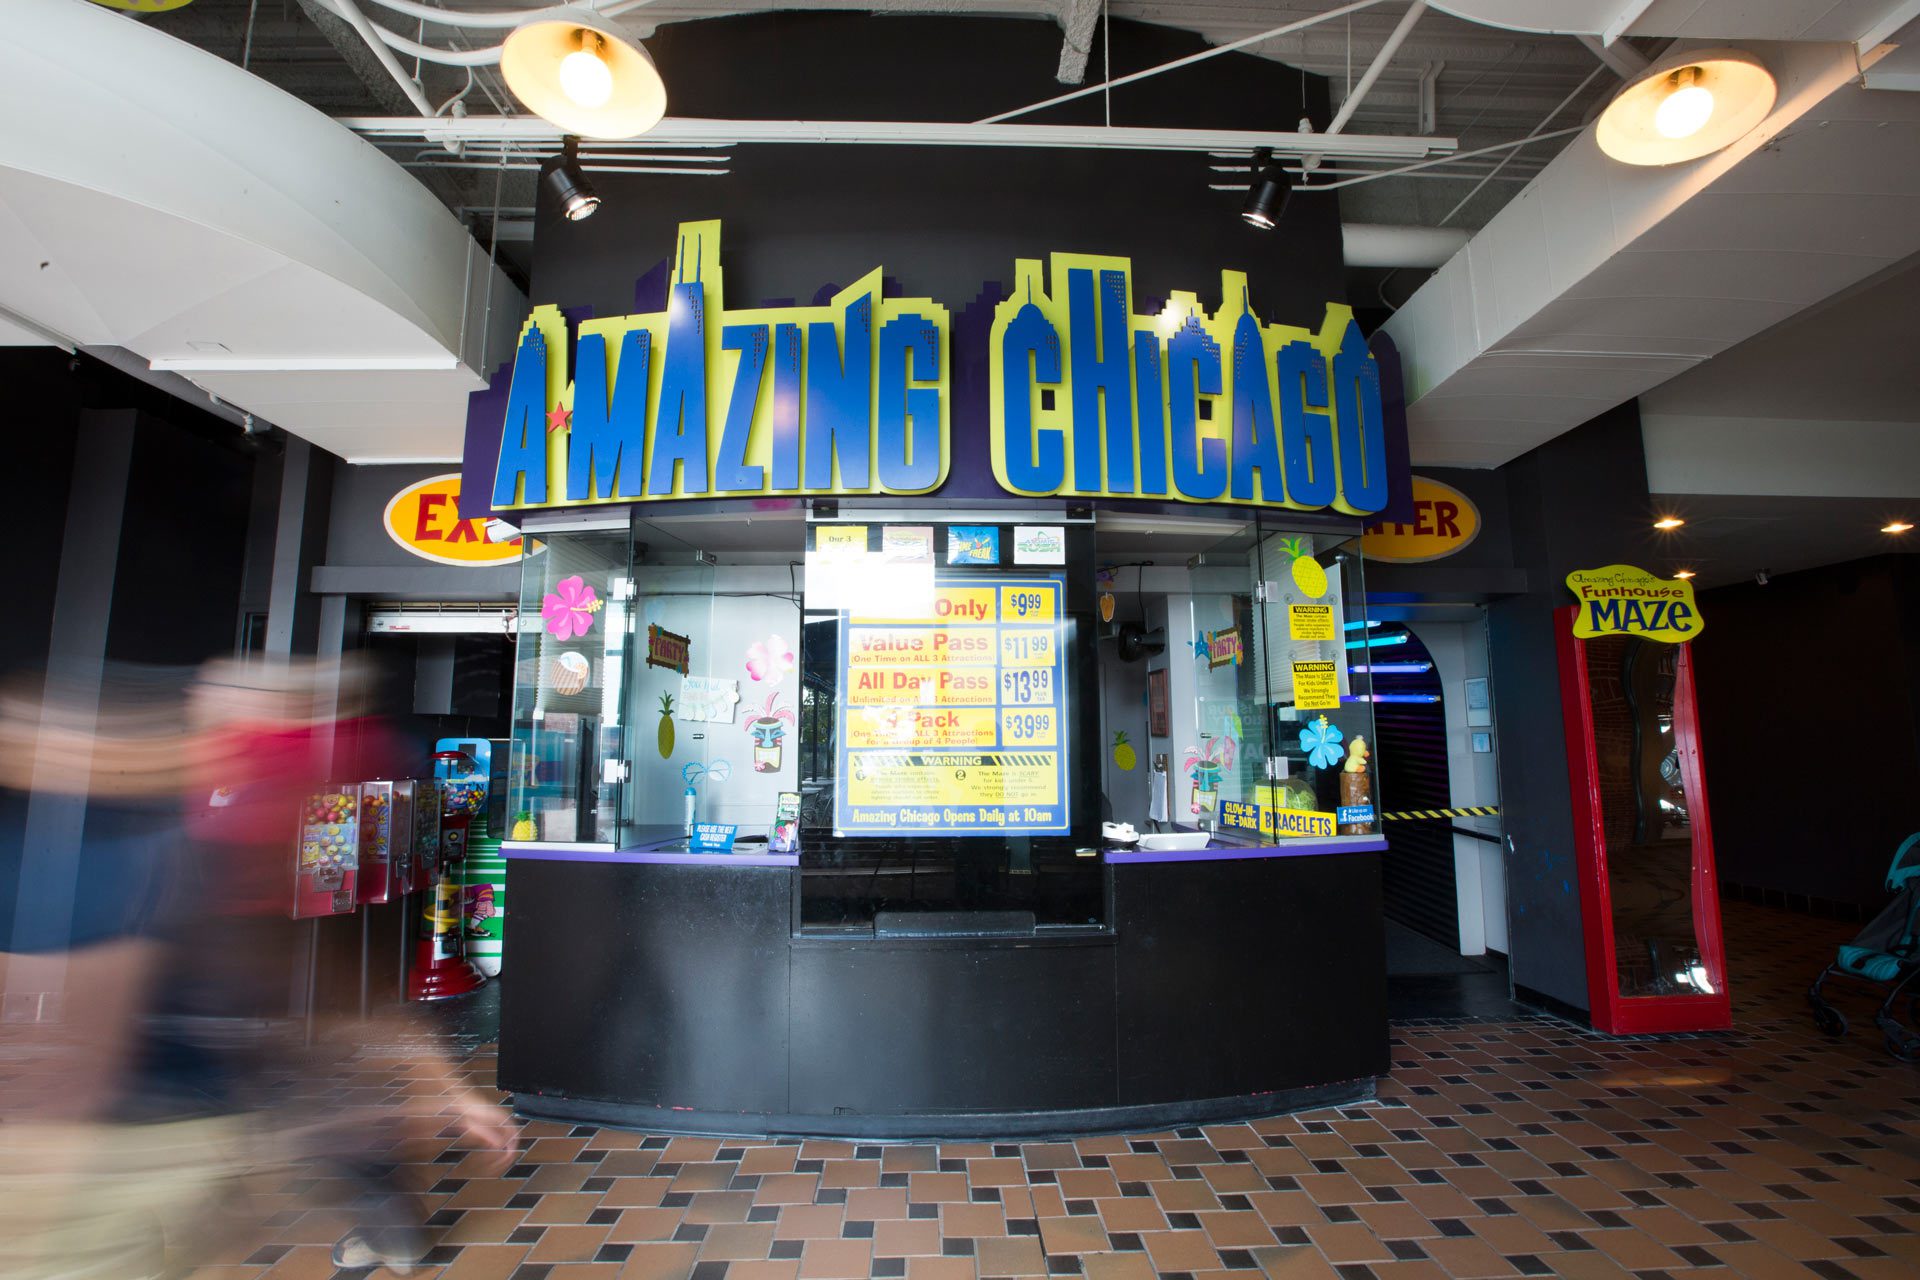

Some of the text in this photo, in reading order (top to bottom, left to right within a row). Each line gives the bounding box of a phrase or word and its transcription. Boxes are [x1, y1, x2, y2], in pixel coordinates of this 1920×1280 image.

[492, 228, 1390, 513] AMAZING CHICAGO
[1581, 585, 1685, 599] Funhouse
[934, 598, 988, 621] Only
[654, 637, 686, 662] PARTY
[860, 633, 924, 652] Value
[933, 633, 989, 652] Pass
[1212, 636, 1237, 660] PARTY
[1295, 663, 1334, 672] WARNING
[858, 671, 885, 689] All
[939, 671, 989, 689] Pass
[922, 737, 934, 745] of
[936, 737, 942, 745] 4
[919, 755, 983, 767] WARNING
[852, 807, 1053, 827] Amazing Chicago Opens Daily at 10am
[1223, 812, 1258, 830] THE-DARK
[1348, 812, 1374, 822] Facebook
